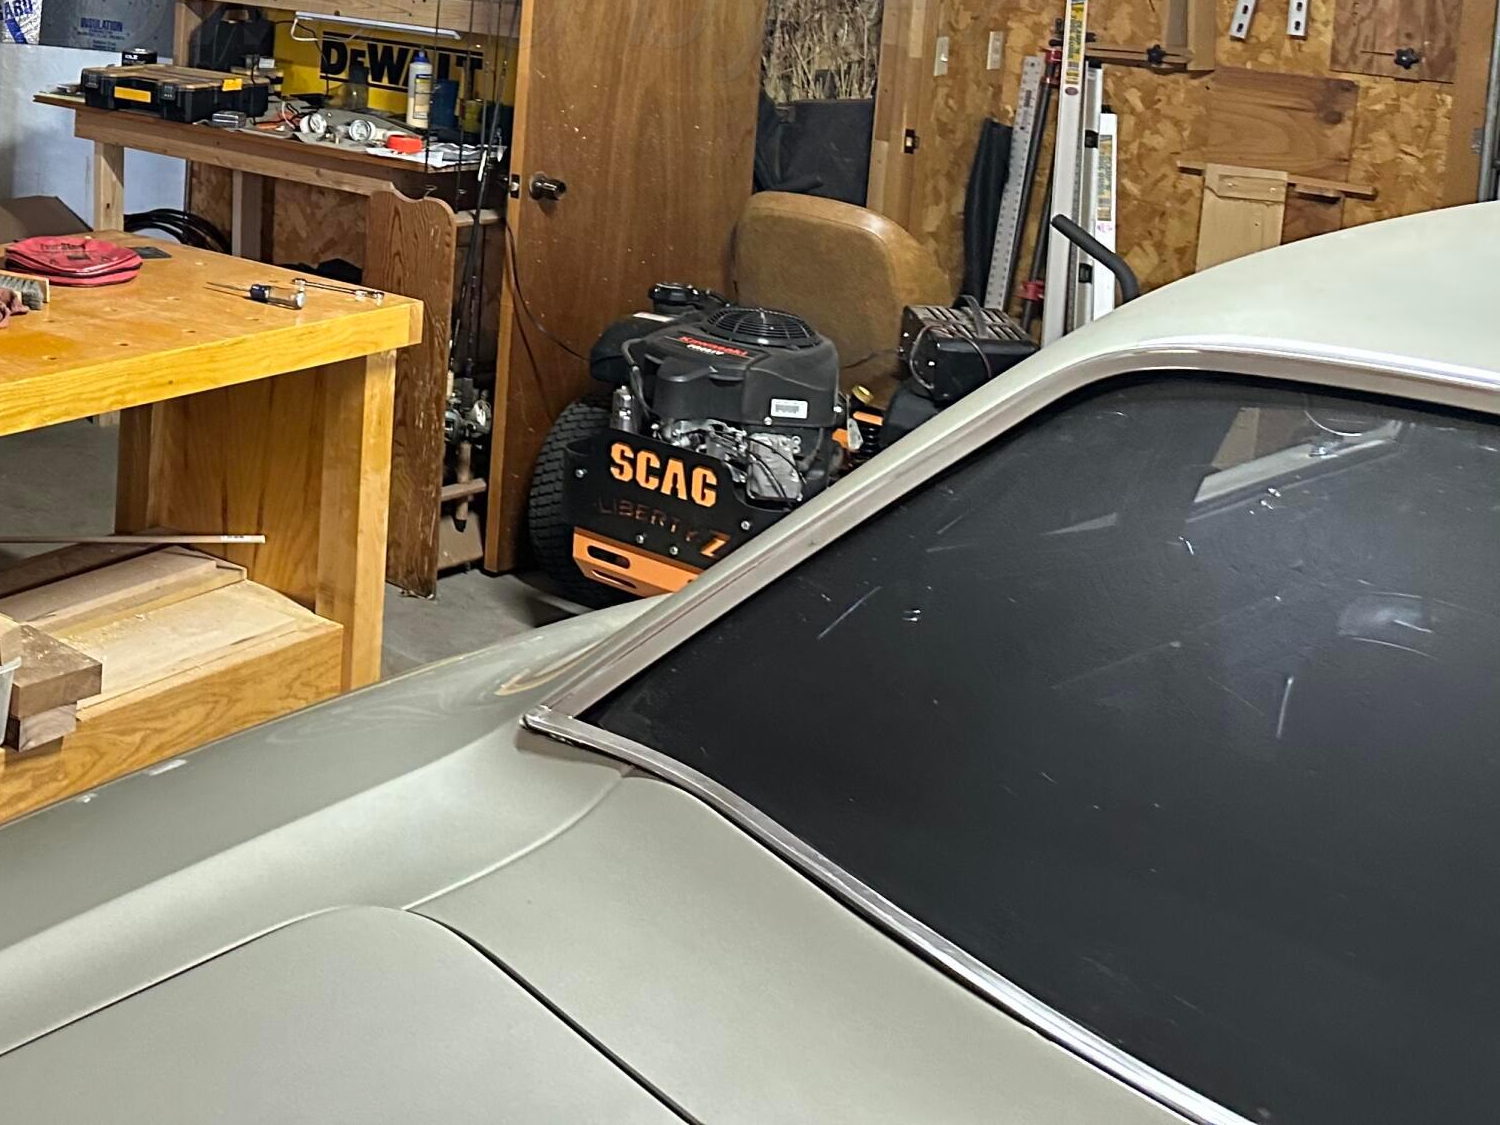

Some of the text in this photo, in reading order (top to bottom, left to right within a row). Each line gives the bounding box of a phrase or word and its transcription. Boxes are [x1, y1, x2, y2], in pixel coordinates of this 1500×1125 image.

[610, 442, 718, 508] SCAG
[597, 495, 732, 558] LIBERTY Z
